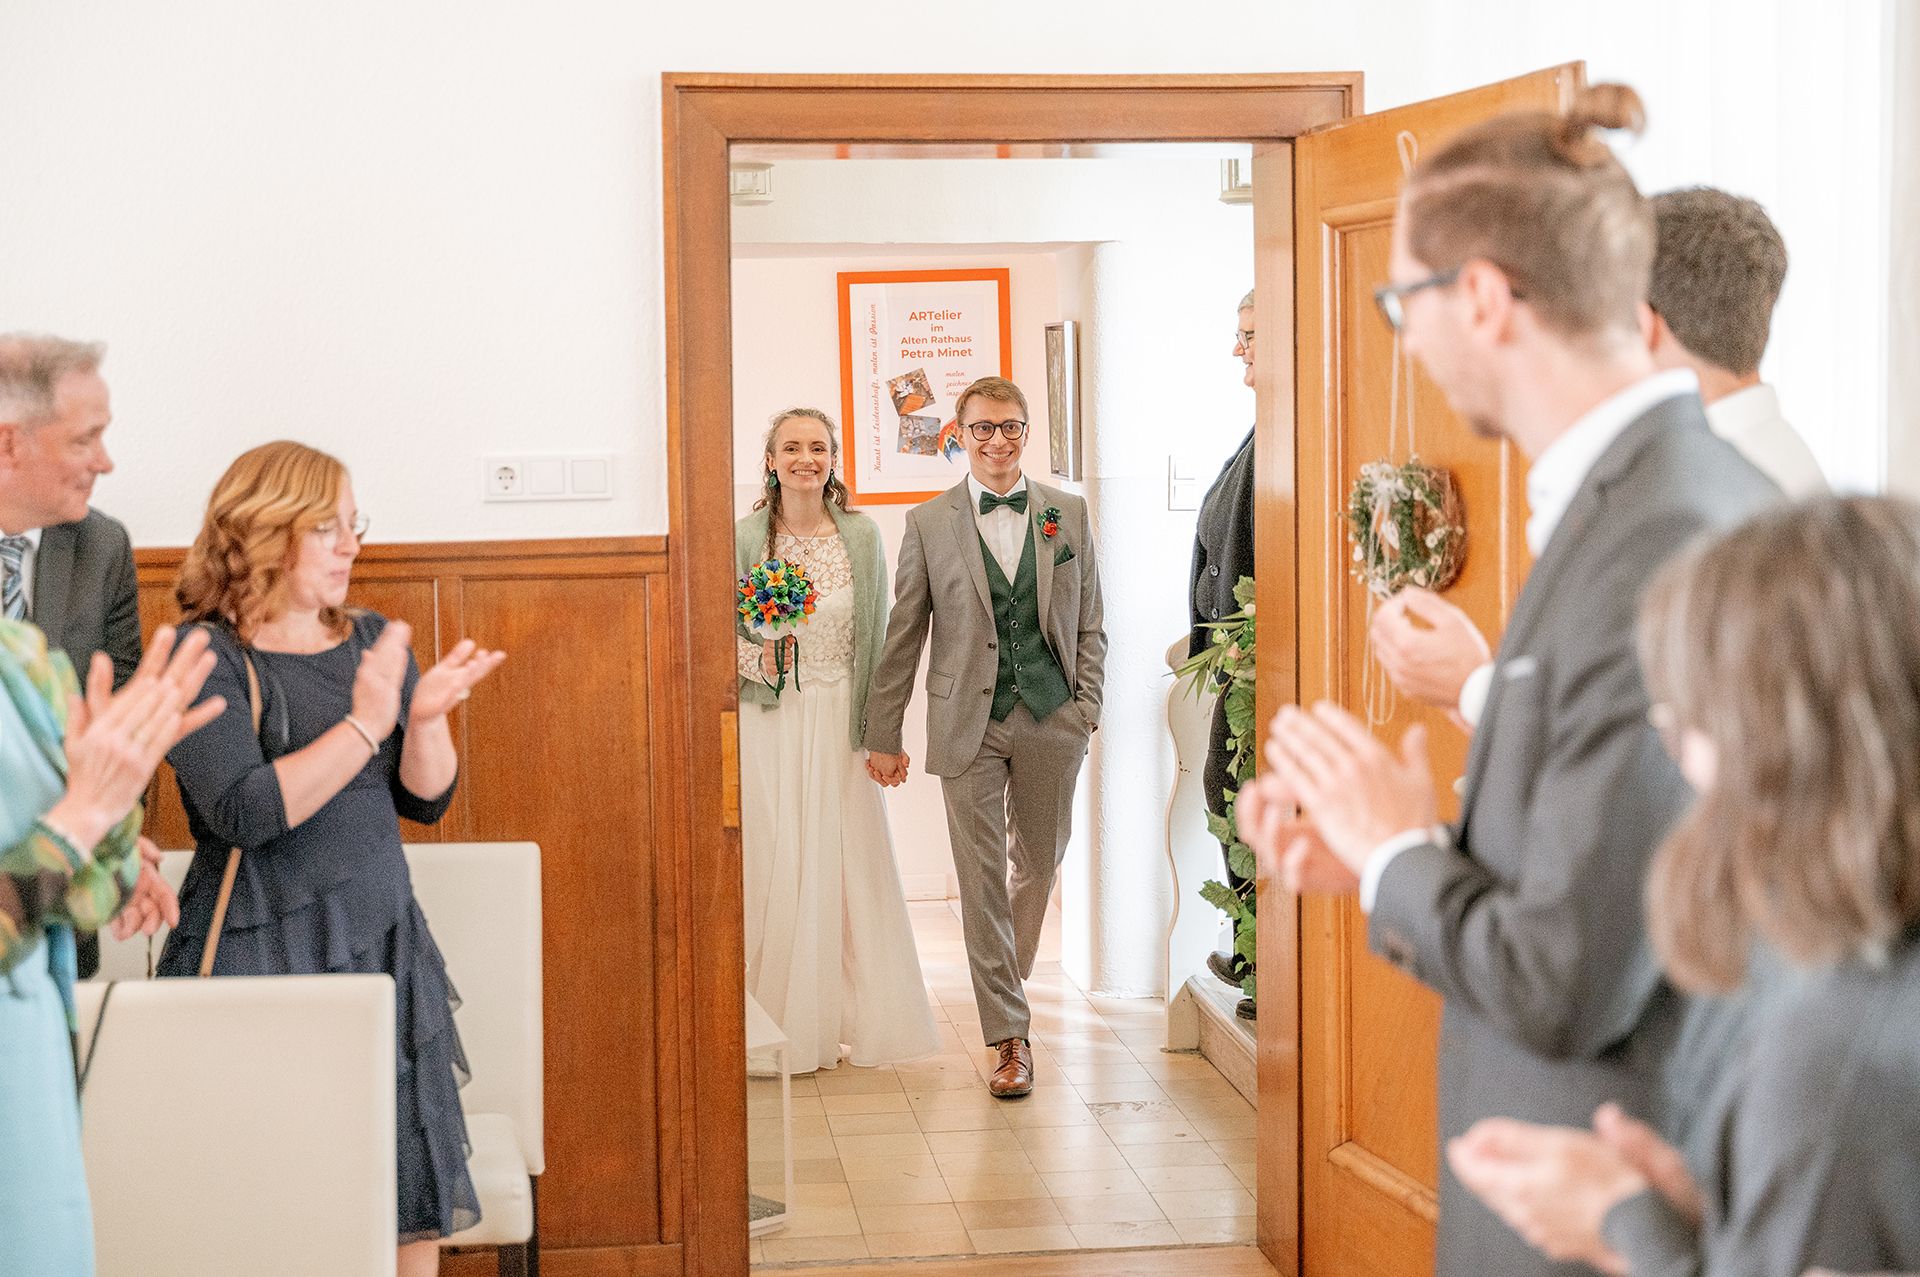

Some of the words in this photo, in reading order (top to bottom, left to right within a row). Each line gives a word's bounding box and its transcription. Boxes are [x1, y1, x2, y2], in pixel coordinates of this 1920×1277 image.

[909, 310, 962, 321] ARTelier
[930, 323, 944, 332] im
[901, 336, 928, 345] Alten
[930, 335, 972, 344] Rathaus
[901, 349, 934, 359] Petra
[937, 347, 973, 358] Minet
